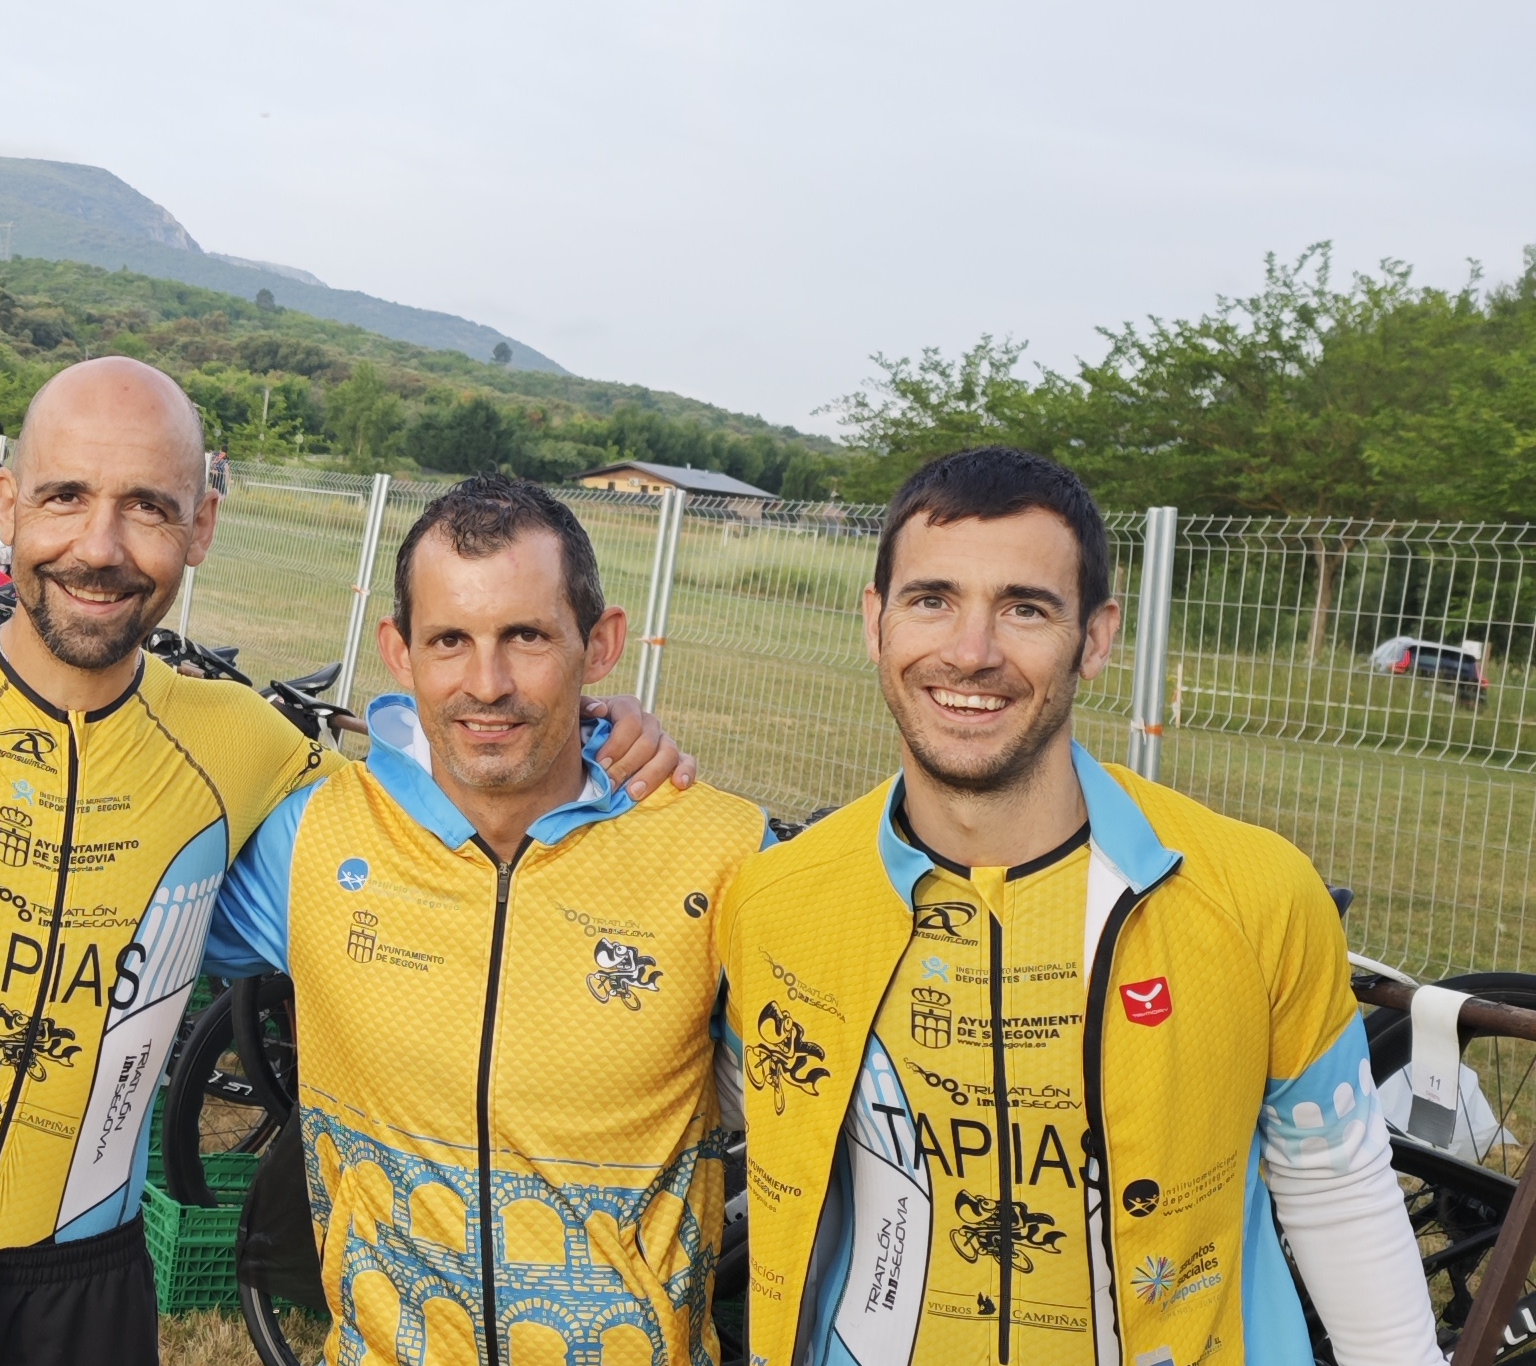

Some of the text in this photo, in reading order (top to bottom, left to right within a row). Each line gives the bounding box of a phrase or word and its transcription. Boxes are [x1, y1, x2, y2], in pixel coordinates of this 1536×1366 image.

[35, 839, 140, 855] AYUNTAMIENTO
[33, 849, 116, 865] DE SEGOVIA
[376, 953, 429, 972] DE SEGOVIA
[377, 944, 444, 965] AYUNTAMIENTO
[1014, 963, 1062, 974] MUNICIPAL
[1066, 961, 1077, 969] DE
[1030, 971, 1077, 982] SEGOVIA
[957, 1026, 1060, 1040] DE SEGOVIA
[1429, 1075, 1441, 1091] 11
[19, 1111, 76, 1136] CAMPIÑAS
[865, 1217, 892, 1314] TRIATLÓN
[928, 1301, 1088, 1328] VIVEROS CAMPIÑAS
